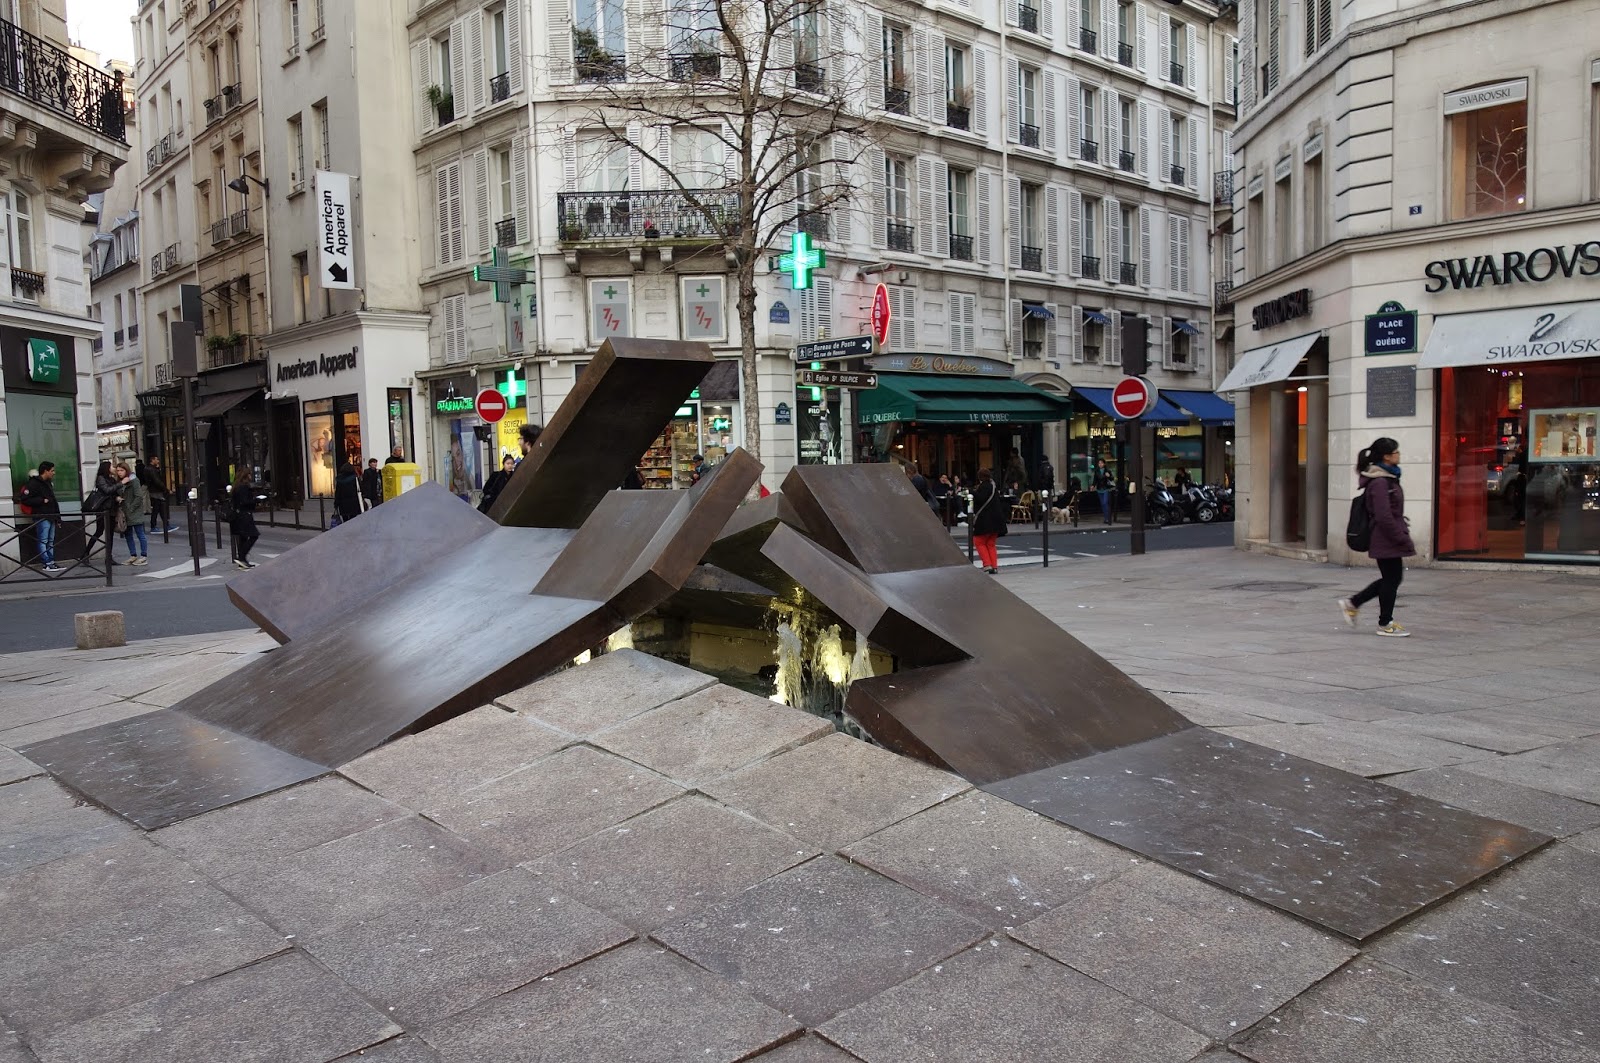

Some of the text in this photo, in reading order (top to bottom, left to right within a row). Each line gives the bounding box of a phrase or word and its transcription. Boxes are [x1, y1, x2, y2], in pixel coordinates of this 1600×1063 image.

[1458, 88, 1511, 106] SWAROVSKI
[322, 190, 335, 255] American
[334, 204, 348, 256] Apparel
[1424, 241, 1600, 293] SWAROVS
[603, 308, 620, 332] 7/7
[694, 306, 712, 330] 7/7
[1378, 320, 1404, 328] PLACE
[813, 343, 832, 352] Bureau
[841, 340, 856, 348] Poste
[1376, 337, 1406, 346] QUÉBEC
[276, 358, 317, 382] American
[908, 356, 930, 370] Le
[142, 396, 166, 406] LIVRES
[437, 398, 474, 411] PHARMACIE
[862, 414, 870, 423] LE
